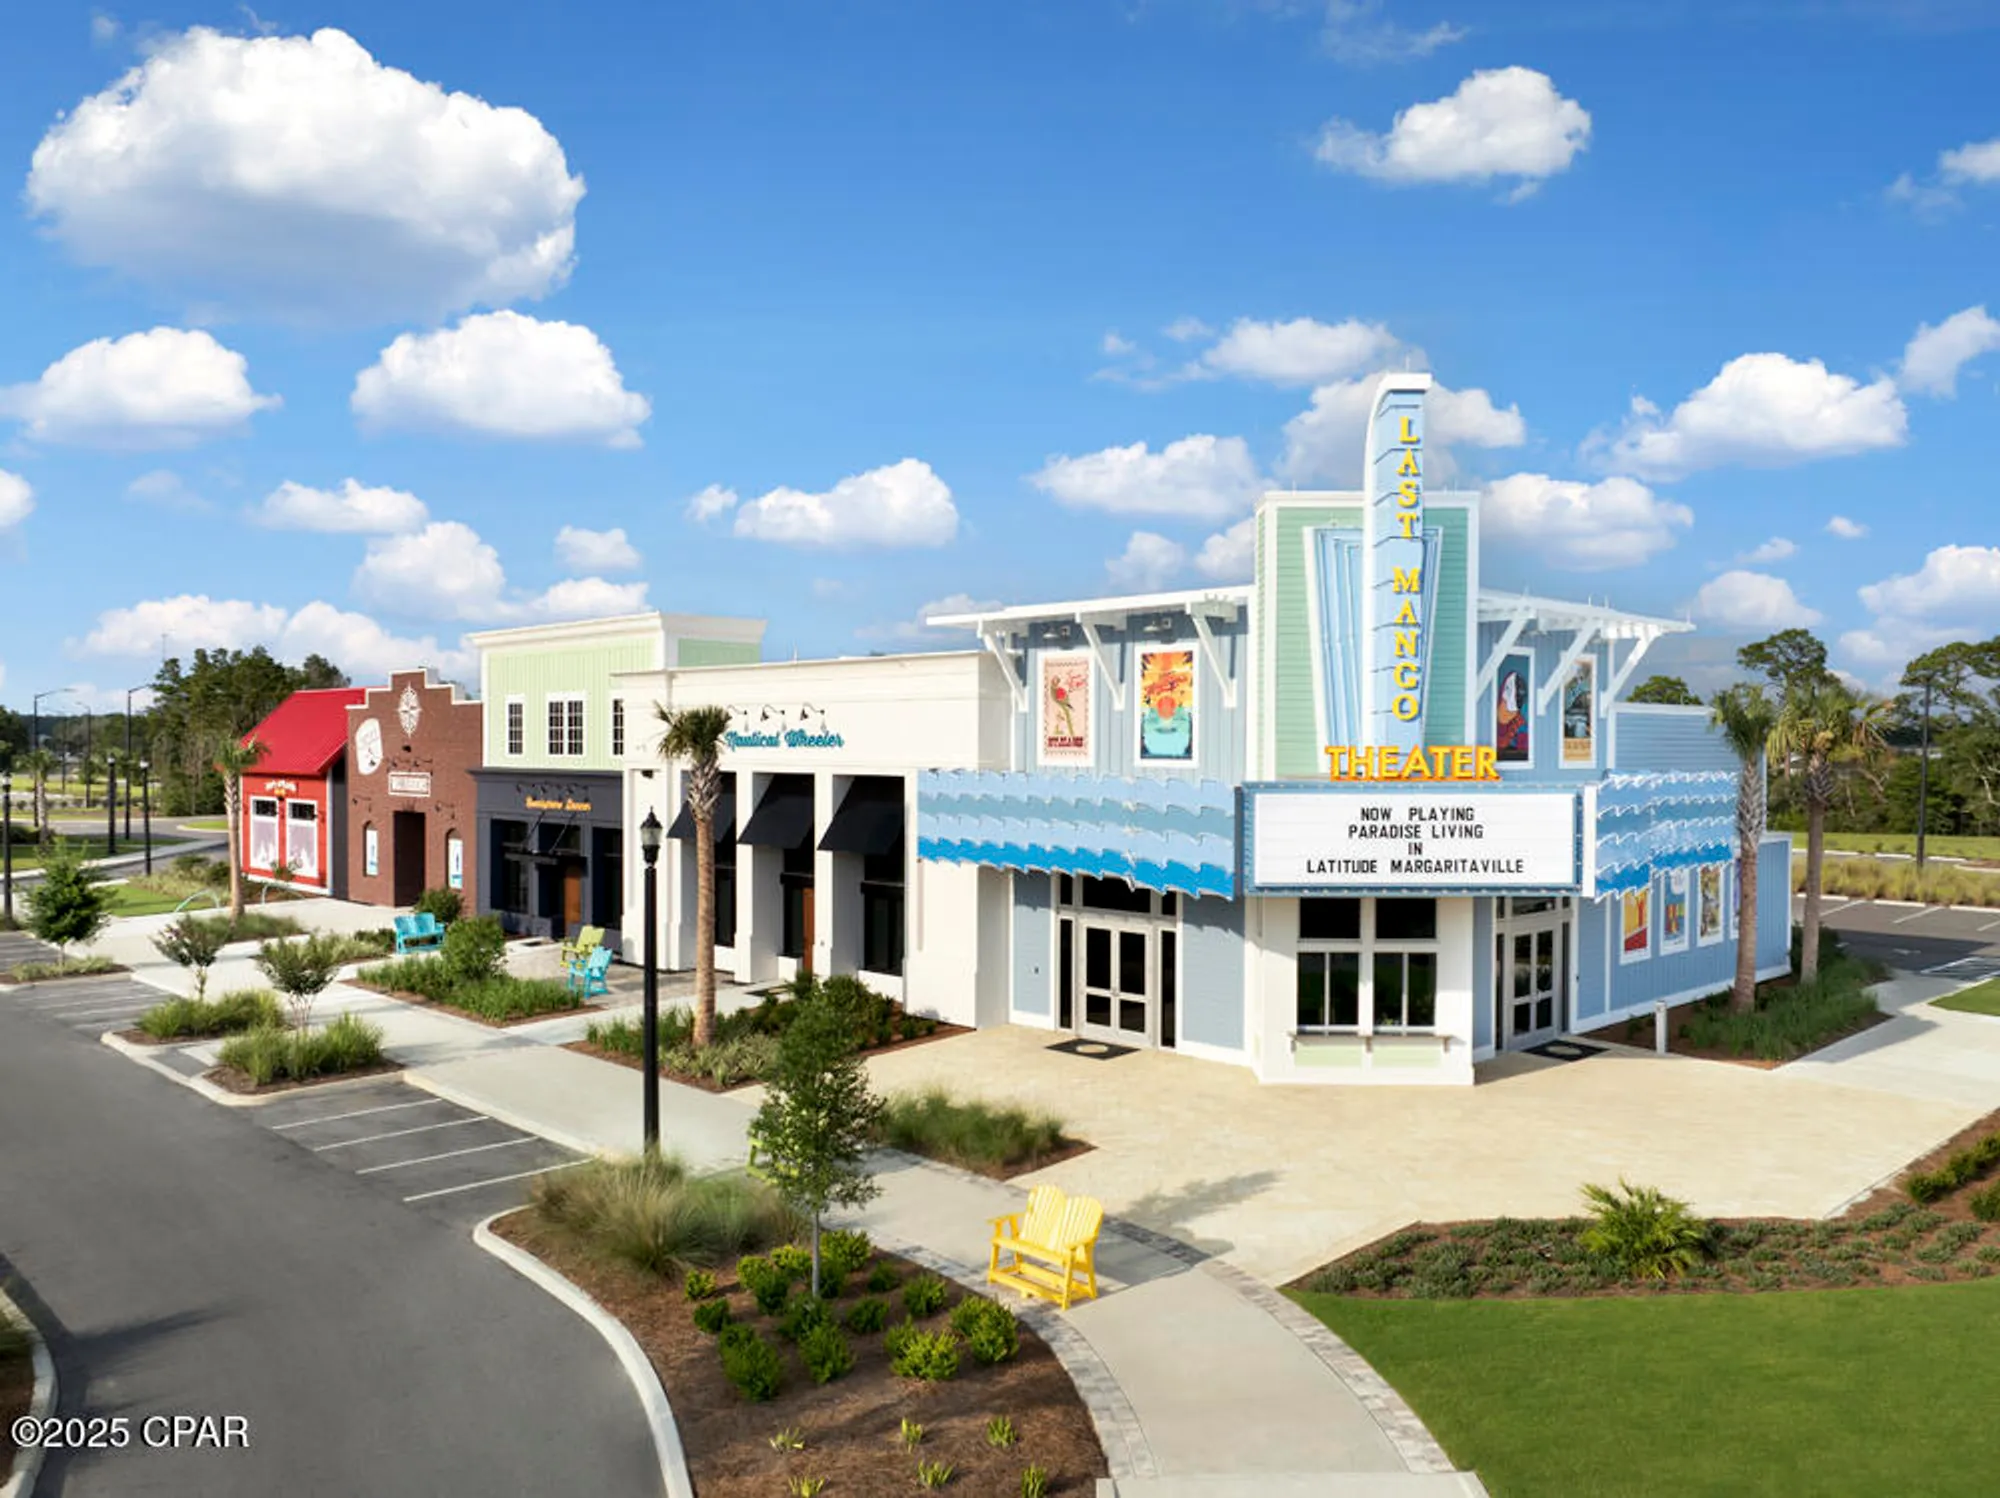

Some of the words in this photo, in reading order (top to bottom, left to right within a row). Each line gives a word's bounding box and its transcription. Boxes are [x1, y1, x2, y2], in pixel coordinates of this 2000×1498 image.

[1396, 416, 1420, 538] LAST
[1391, 567, 1420, 721] MANGO
[725, 730, 780, 751] Nautical
[1325, 744, 1500, 782] THEATER
[1361, 807, 1392, 822] NOW
[1408, 807, 1474, 822] PLAYING
[1348, 824, 1421, 839] PARADISE
[1431, 824, 1484, 839] LIVING
[1408, 842, 1423, 856] IN
[1307, 859, 1378, 874] LATITUDE
[1390, 859, 1523, 874] MARGARITAVILLE
